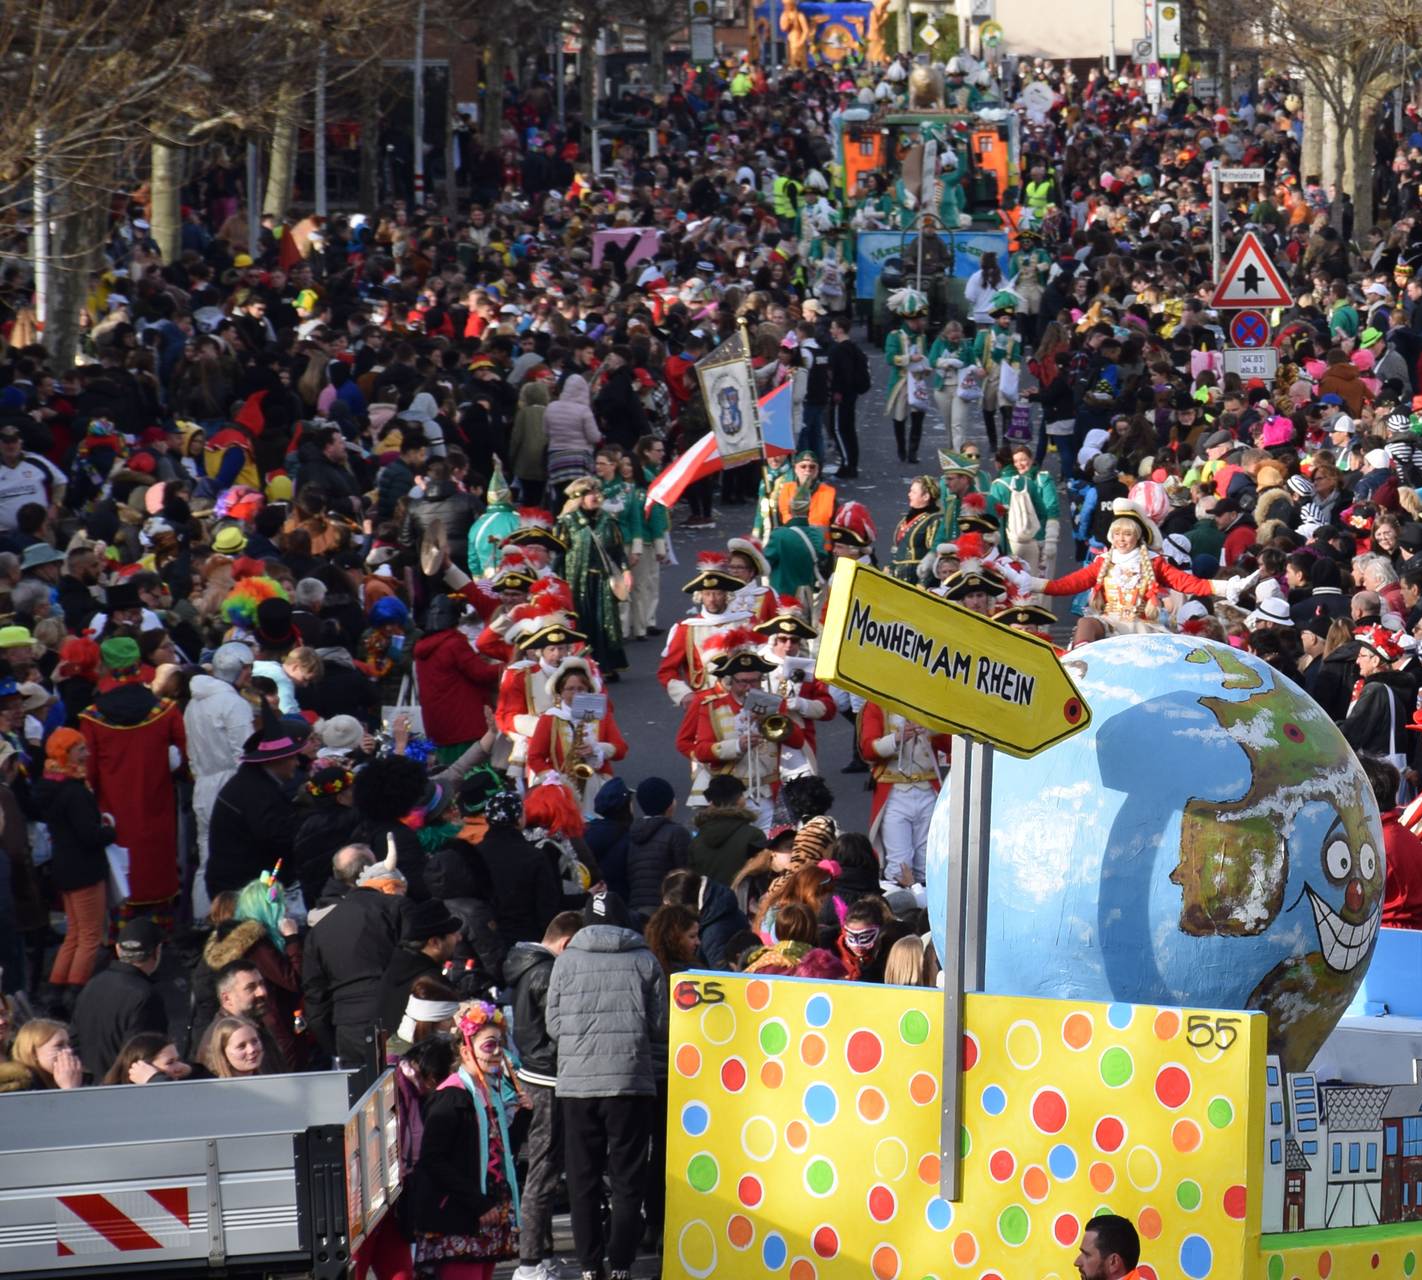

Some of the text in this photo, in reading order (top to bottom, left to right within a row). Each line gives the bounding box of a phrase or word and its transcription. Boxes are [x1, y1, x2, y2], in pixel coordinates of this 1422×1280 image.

[931, 646, 972, 685] AM
[976, 655, 1035, 706] RHEIN
[1186, 1015, 1242, 1050] 55
